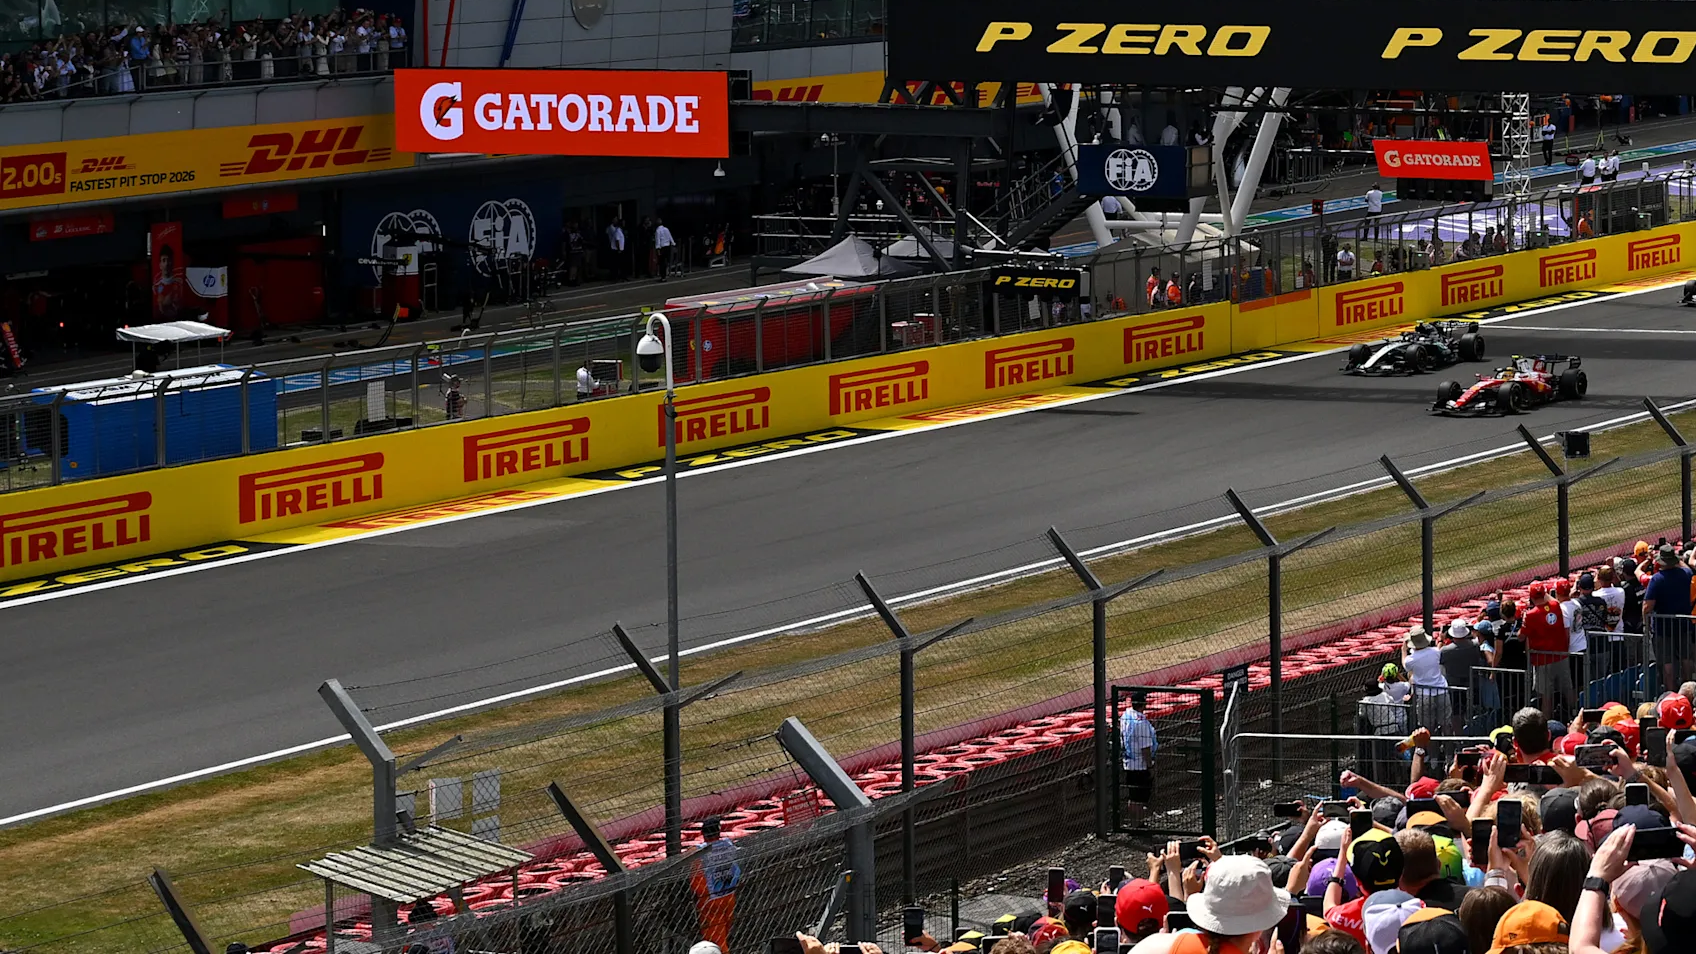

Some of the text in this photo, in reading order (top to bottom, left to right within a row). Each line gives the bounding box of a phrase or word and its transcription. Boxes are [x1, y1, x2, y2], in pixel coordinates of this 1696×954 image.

[976, 22, 1271, 57] P ZERO
[1382, 27, 1443, 59] P
[420, 81, 700, 140] G GATORADE
[80, 156, 128, 174] DHL
[243, 125, 370, 177] DHL
[1403, 153, 1481, 167] GATORADE
[2, 161, 62, 192] 2.00s
[70, 170, 195, 192] FASTEST PIT STOP 2026
[1540, 249, 1597, 288] PIRELLI
[1628, 233, 1681, 271] PIRELLI
[995, 276, 1076, 289] P ZERO
[1442, 264, 1503, 307] PIRELLI
[1336, 281, 1404, 328] PIRELLI
[1123, 315, 1205, 364] PIRELLI
[985, 337, 1075, 402] PIRELLI
[1151, 351, 1283, 379] ZERO
[829, 360, 930, 416] PIRELLI
[658, 386, 771, 447] PIRELLI
[463, 416, 591, 483] PIRELLI
[682, 428, 860, 467] ZERO
[239, 451, 384, 524] PIRELLI
[0, 491, 153, 568] PIRELLI
